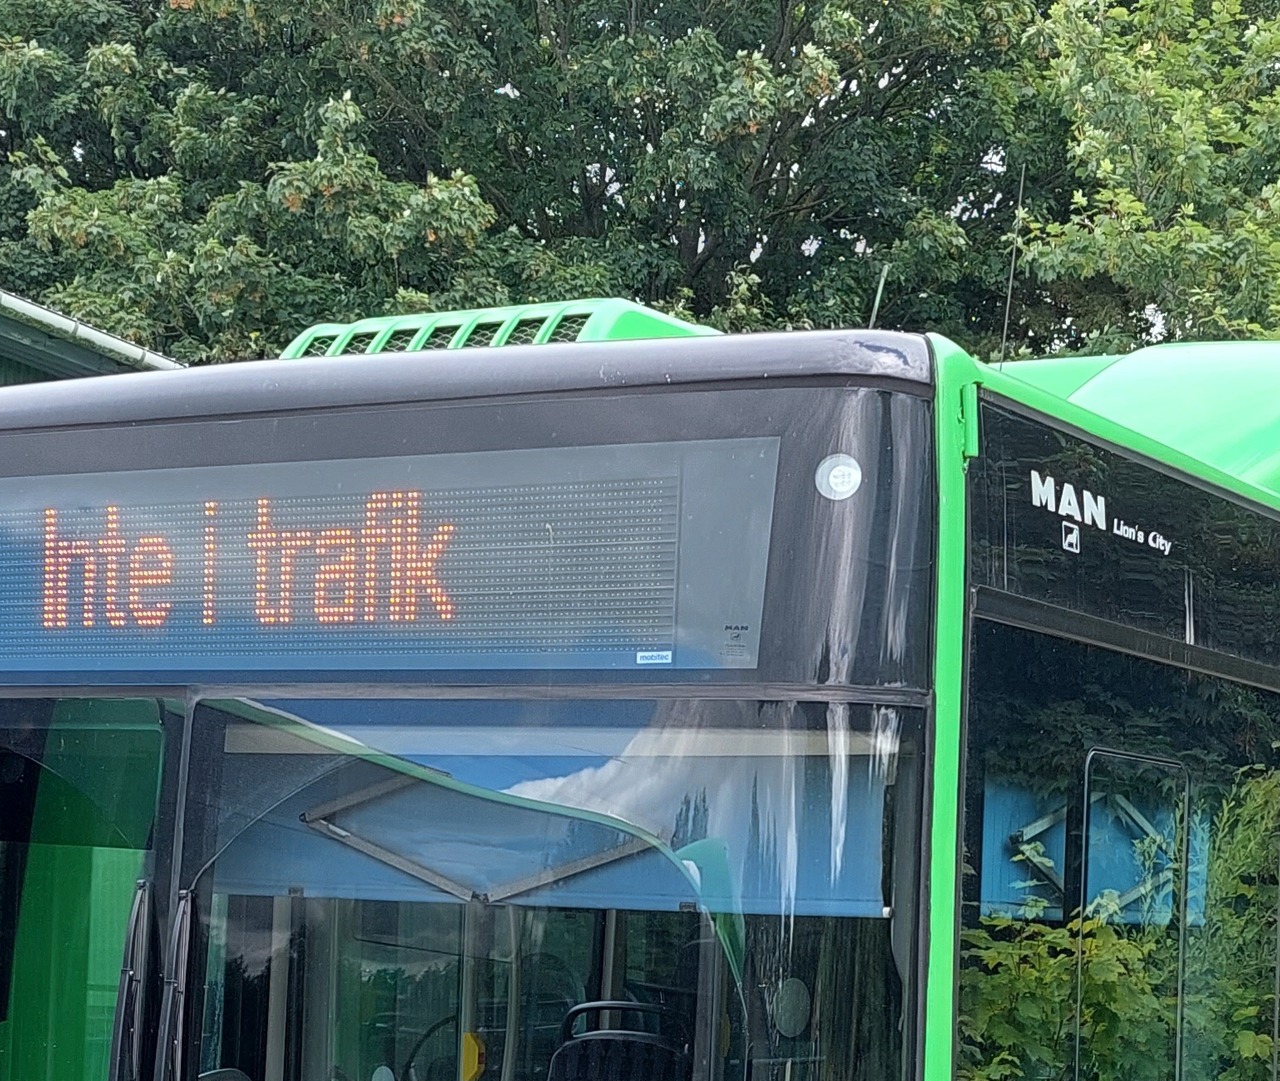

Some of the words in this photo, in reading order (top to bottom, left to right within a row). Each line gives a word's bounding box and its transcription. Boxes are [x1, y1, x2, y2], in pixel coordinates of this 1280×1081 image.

[1031, 470, 1107, 531] MAN
[42, 507, 174, 628] Inte
[203, 501, 217, 625] i
[246, 491, 455, 624] trafik
[1113, 518, 1145, 544] Lion's
[1148, 531, 1172, 556] City
[639, 652, 670, 662] mobitec
